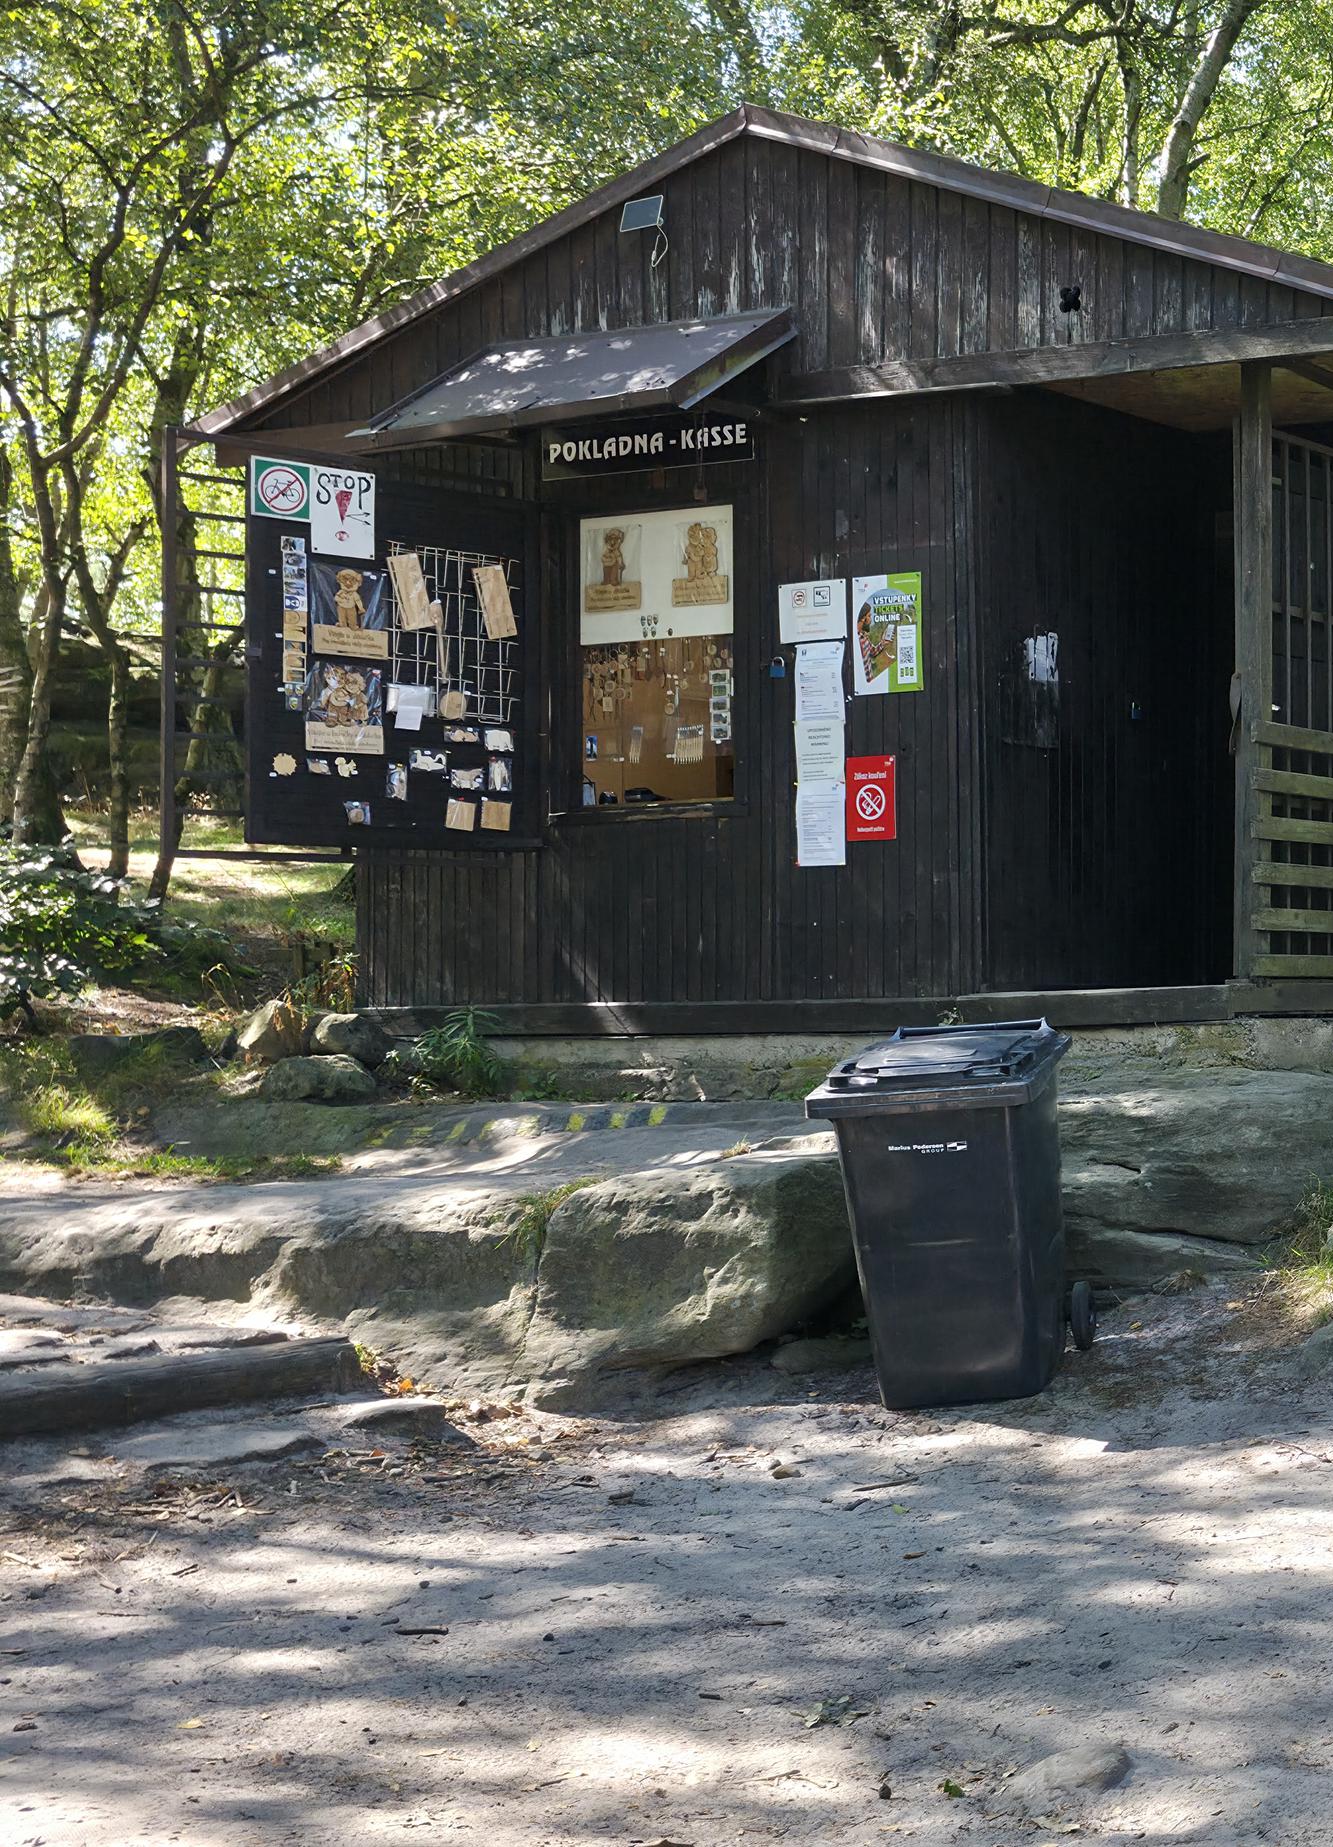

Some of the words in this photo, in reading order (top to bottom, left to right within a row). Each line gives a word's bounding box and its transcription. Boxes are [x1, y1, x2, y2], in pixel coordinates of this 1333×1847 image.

[550, 432, 663, 463] POKLADNA
[681, 424, 747, 449] KASSE
[316, 473, 371, 509] STOP
[873, 594, 916, 605] VSTUPENKY
[874, 604, 904, 614] TICKETS
[874, 613, 900, 623] ONLINE
